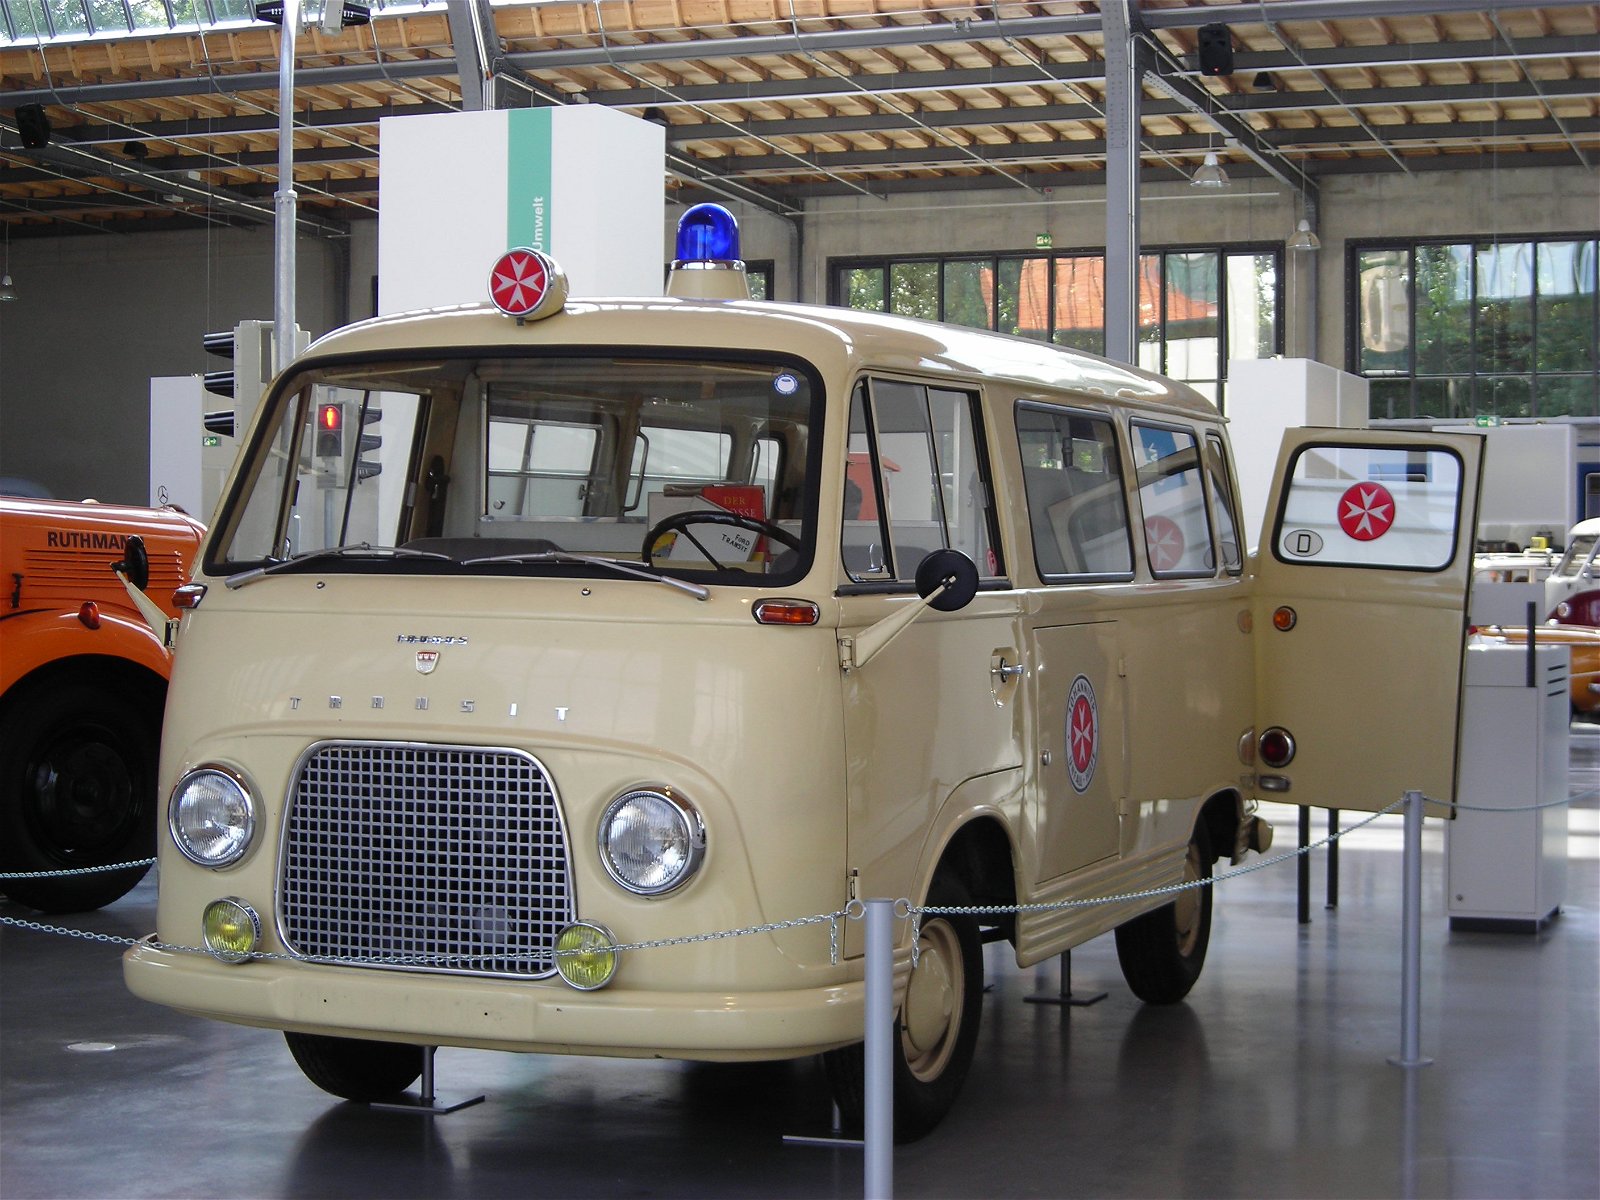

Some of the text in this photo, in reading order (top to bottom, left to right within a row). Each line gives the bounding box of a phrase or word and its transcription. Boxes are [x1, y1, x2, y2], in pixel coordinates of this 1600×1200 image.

[532, 196, 543, 251] Umwelt
[723, 496, 746, 505] DER
[721, 533, 747, 552] TRANSIT
[735, 534, 750, 546] FORD
[1296, 534, 1311, 553] D
[290, 695, 569, 721] TRANSIT
